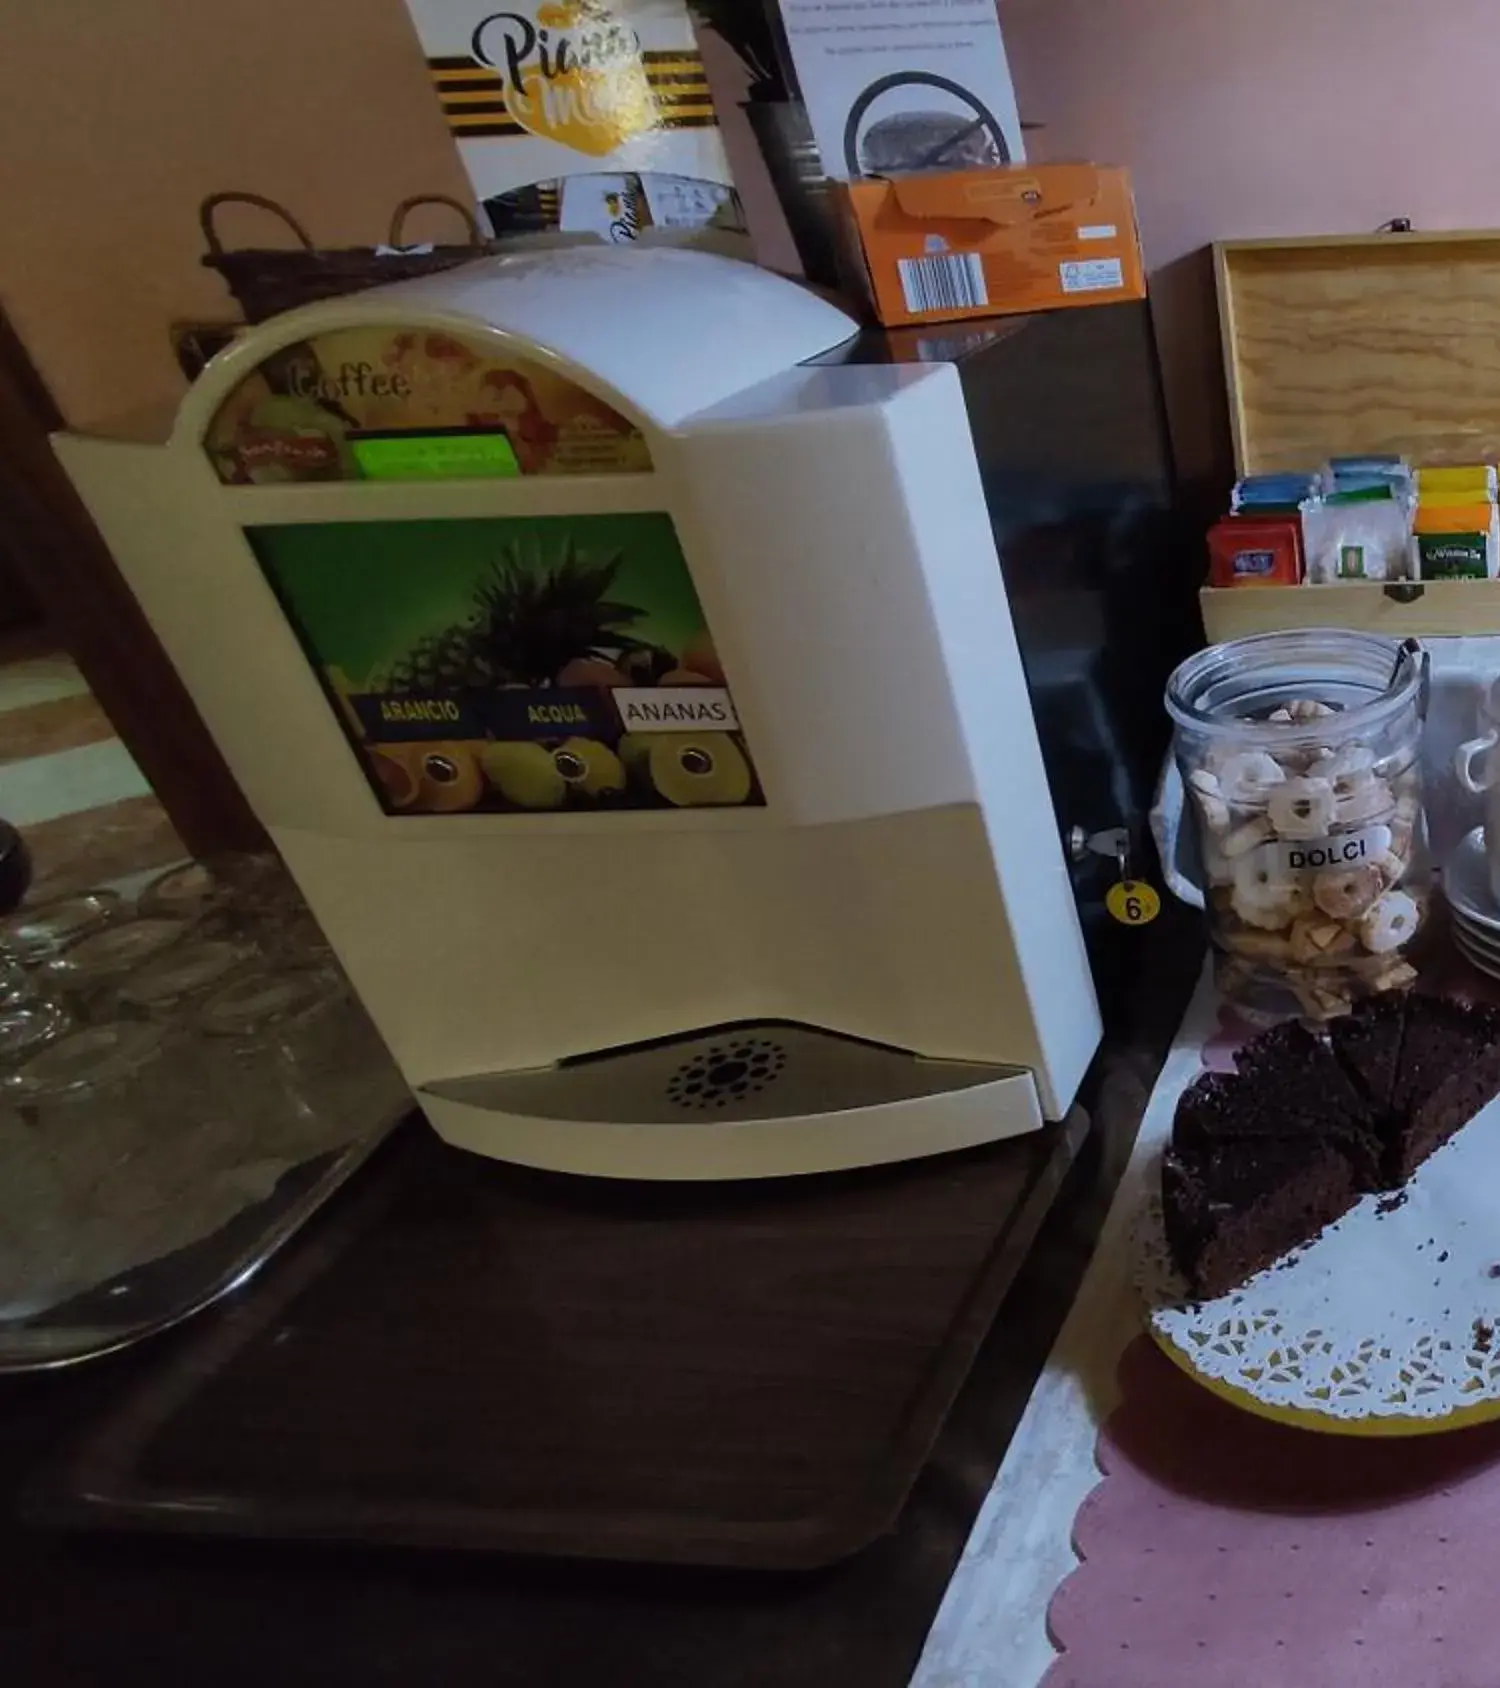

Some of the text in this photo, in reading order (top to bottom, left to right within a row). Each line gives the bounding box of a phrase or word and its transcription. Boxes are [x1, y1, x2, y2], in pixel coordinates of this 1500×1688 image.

[380, 700, 460, 722] ARANCIO
[527, 704, 588, 724] ACQUA
[626, 702, 727, 721] ANANAS
[1289, 839, 1366, 869] DOLCI
[1126, 896, 1141, 920] 6
